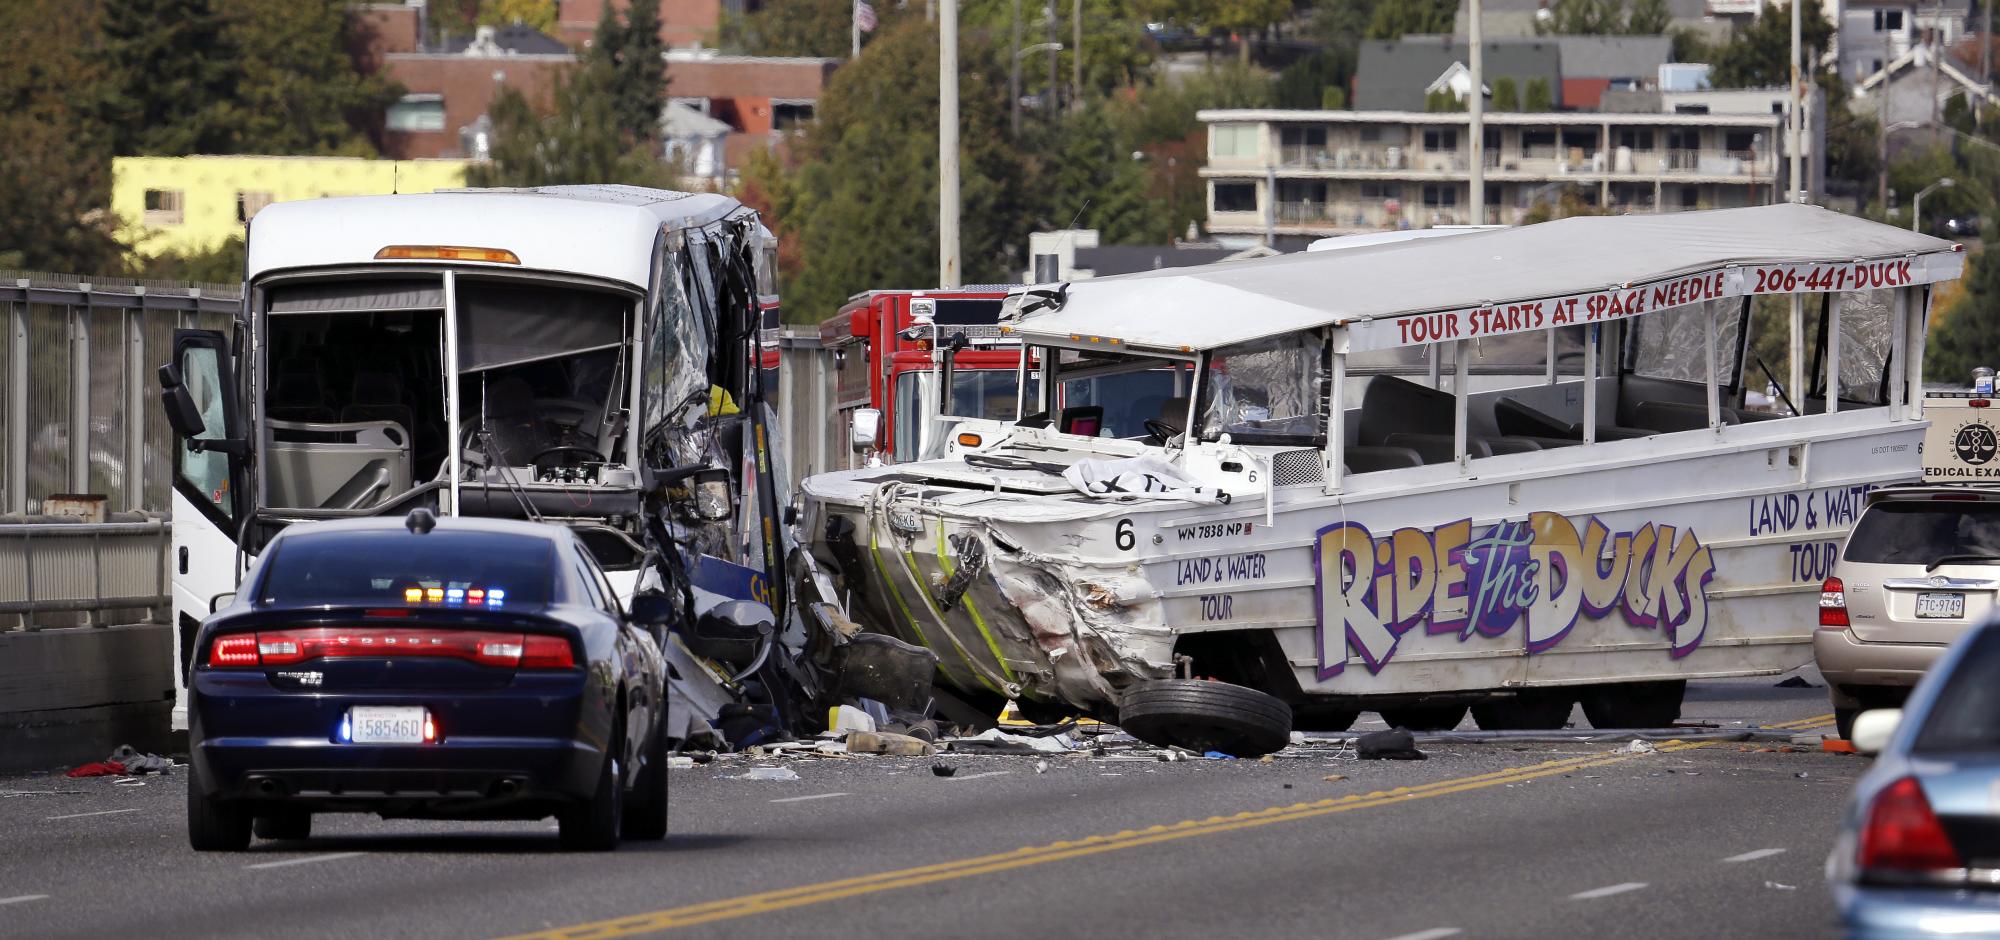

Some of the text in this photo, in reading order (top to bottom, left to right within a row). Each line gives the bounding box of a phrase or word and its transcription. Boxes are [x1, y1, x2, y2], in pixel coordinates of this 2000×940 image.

[1753, 259, 1912, 293] 206-441-DUCK
[1397, 272, 1724, 343] TOUR STARTS AT SPACE NEEDLE
[949, 440, 954, 453] 6
[1918, 442, 1924, 454] 6
[1248, 470, 1257, 483] 6
[1921, 467, 1972, 477] EDICAL
[1750, 483, 1881, 537] LAND & WAT
[1115, 518, 1136, 552] 6
[1178, 522, 1242, 540] WN 7838 NP
[1177, 552, 1266, 586] LAND & WATER
[1200, 594, 1233, 621] TOUR
